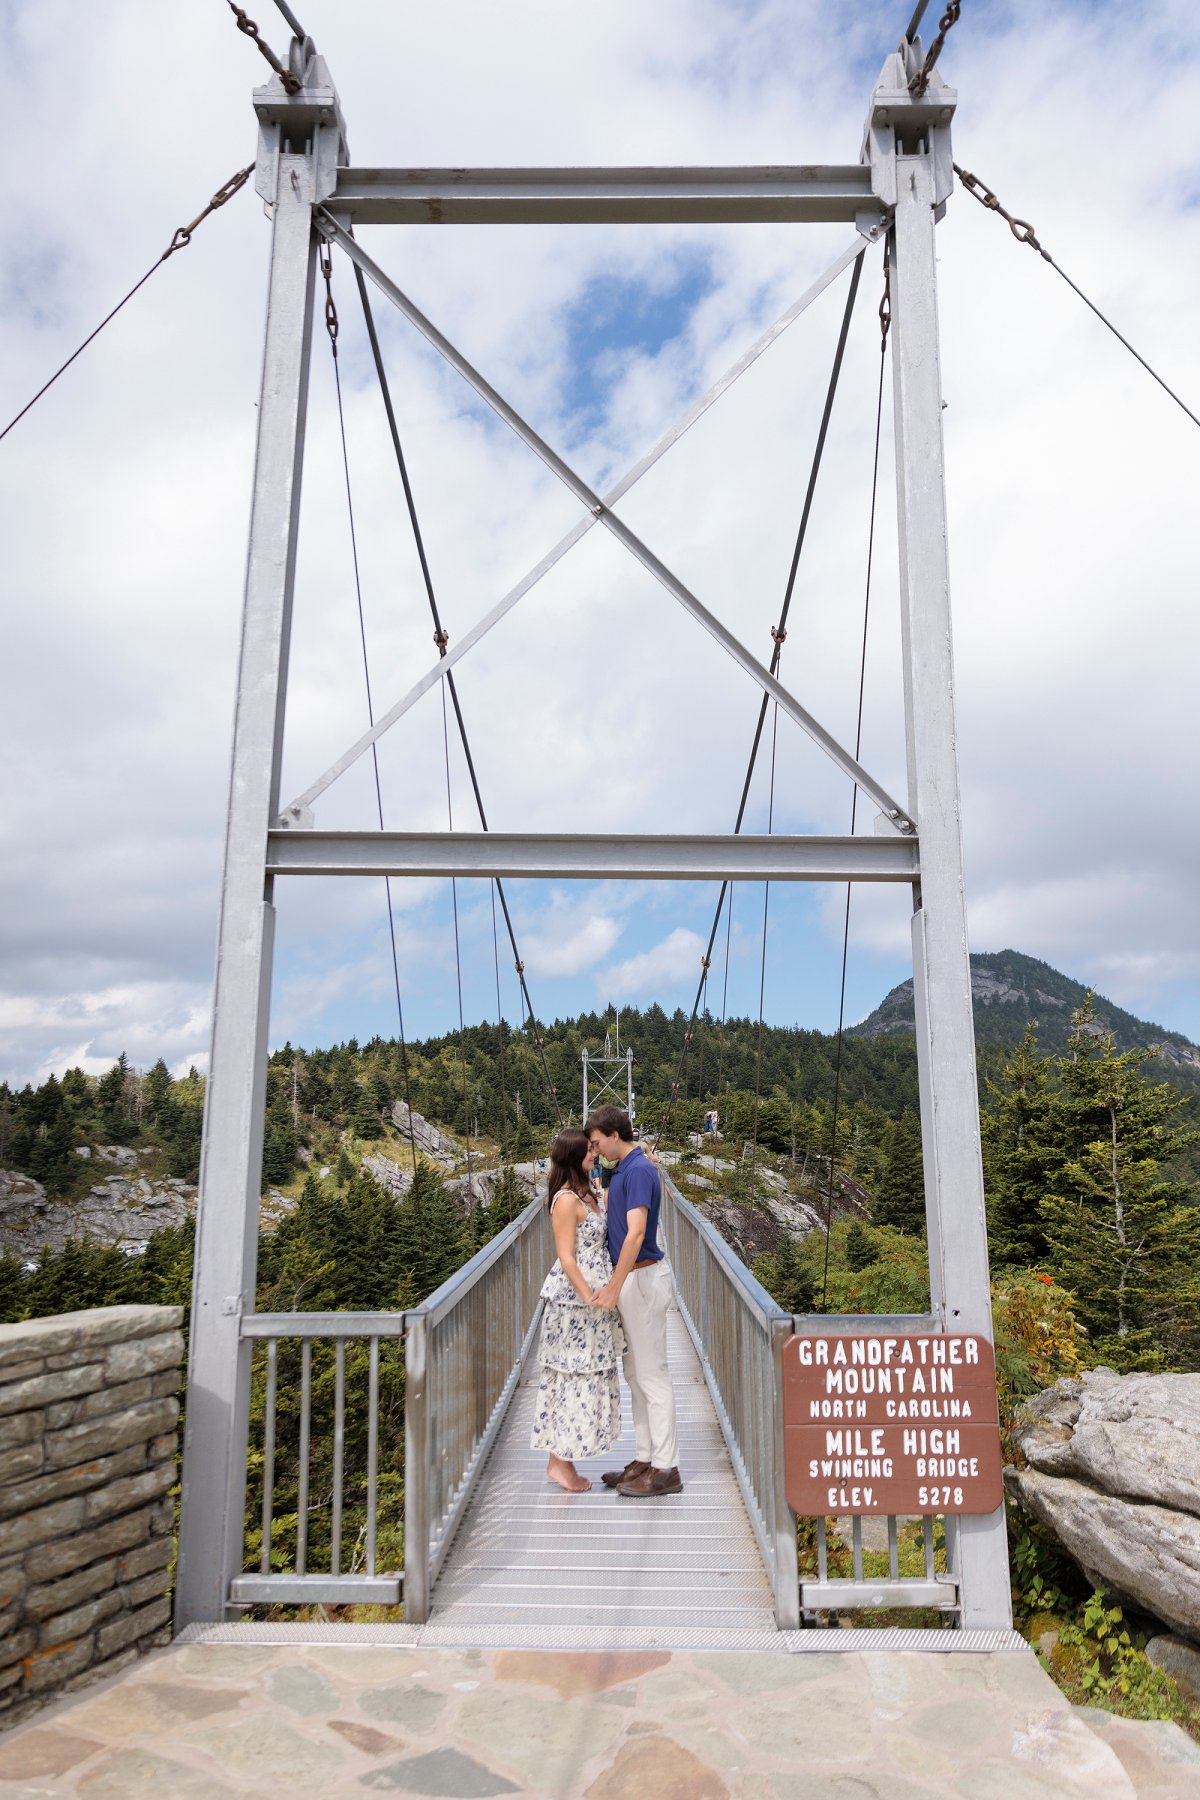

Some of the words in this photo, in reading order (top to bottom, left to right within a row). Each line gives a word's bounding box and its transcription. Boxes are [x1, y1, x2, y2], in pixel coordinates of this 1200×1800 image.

[799, 1338, 978, 1365] GRANDFATHER
[826, 1367, 953, 1394] MOUNTAIN
[810, 1399, 866, 1417] NORTH
[886, 1399, 971, 1417] CAROLINA
[826, 1429, 885, 1456] MILE
[904, 1429, 960, 1455] HIGH
[810, 1458, 892, 1478] SWINGING
[917, 1458, 978, 1477] BRIDGE
[828, 1487, 877, 1507] ELEV.
[919, 1487, 963, 1505] 5278
